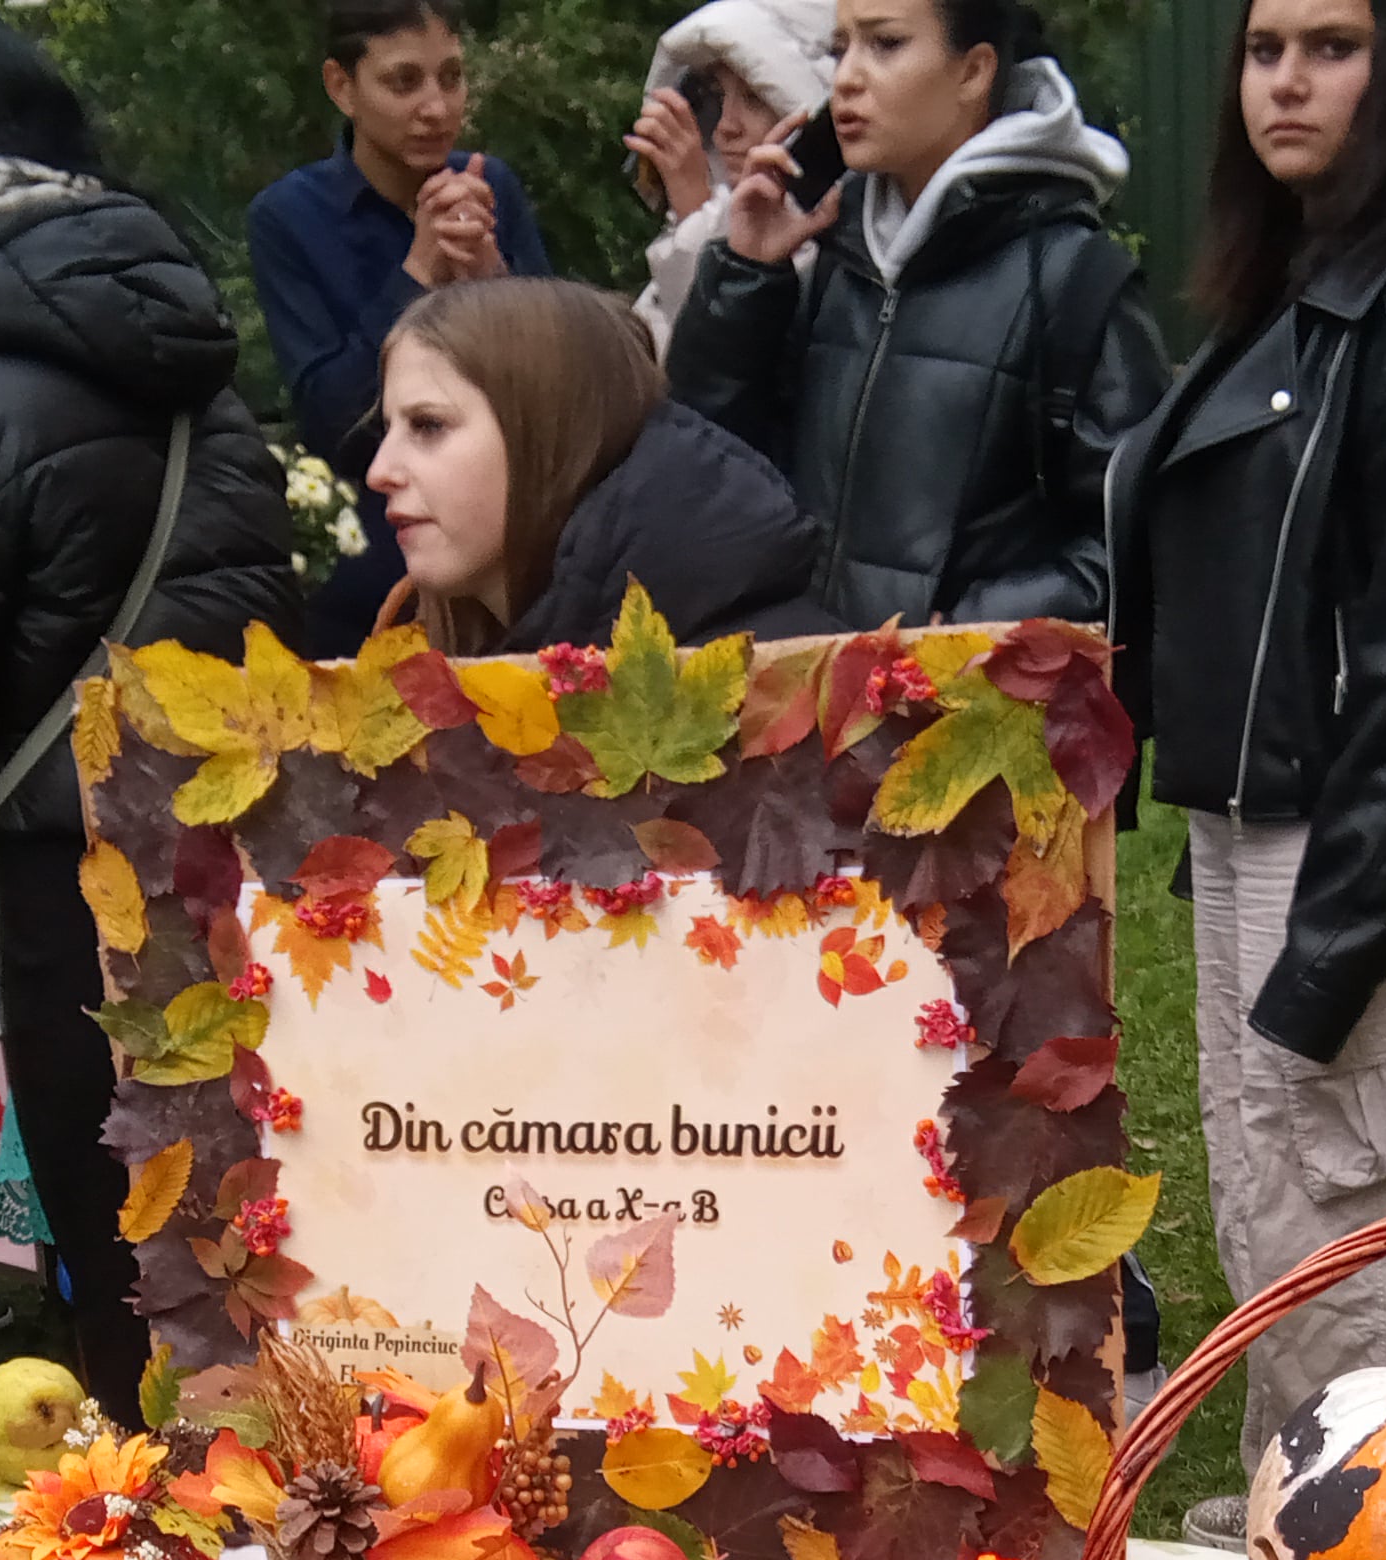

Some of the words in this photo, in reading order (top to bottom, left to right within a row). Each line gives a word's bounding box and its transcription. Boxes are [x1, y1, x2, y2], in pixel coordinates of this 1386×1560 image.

[361, 1100, 452, 1153] Din
[461, 1106, 661, 1156] cămara
[670, 1103, 845, 1158] bunicii
[586, 1198, 611, 1221] a
[691, 1188, 720, 1224] B
[373, 1331, 459, 1357] Popinciuc
